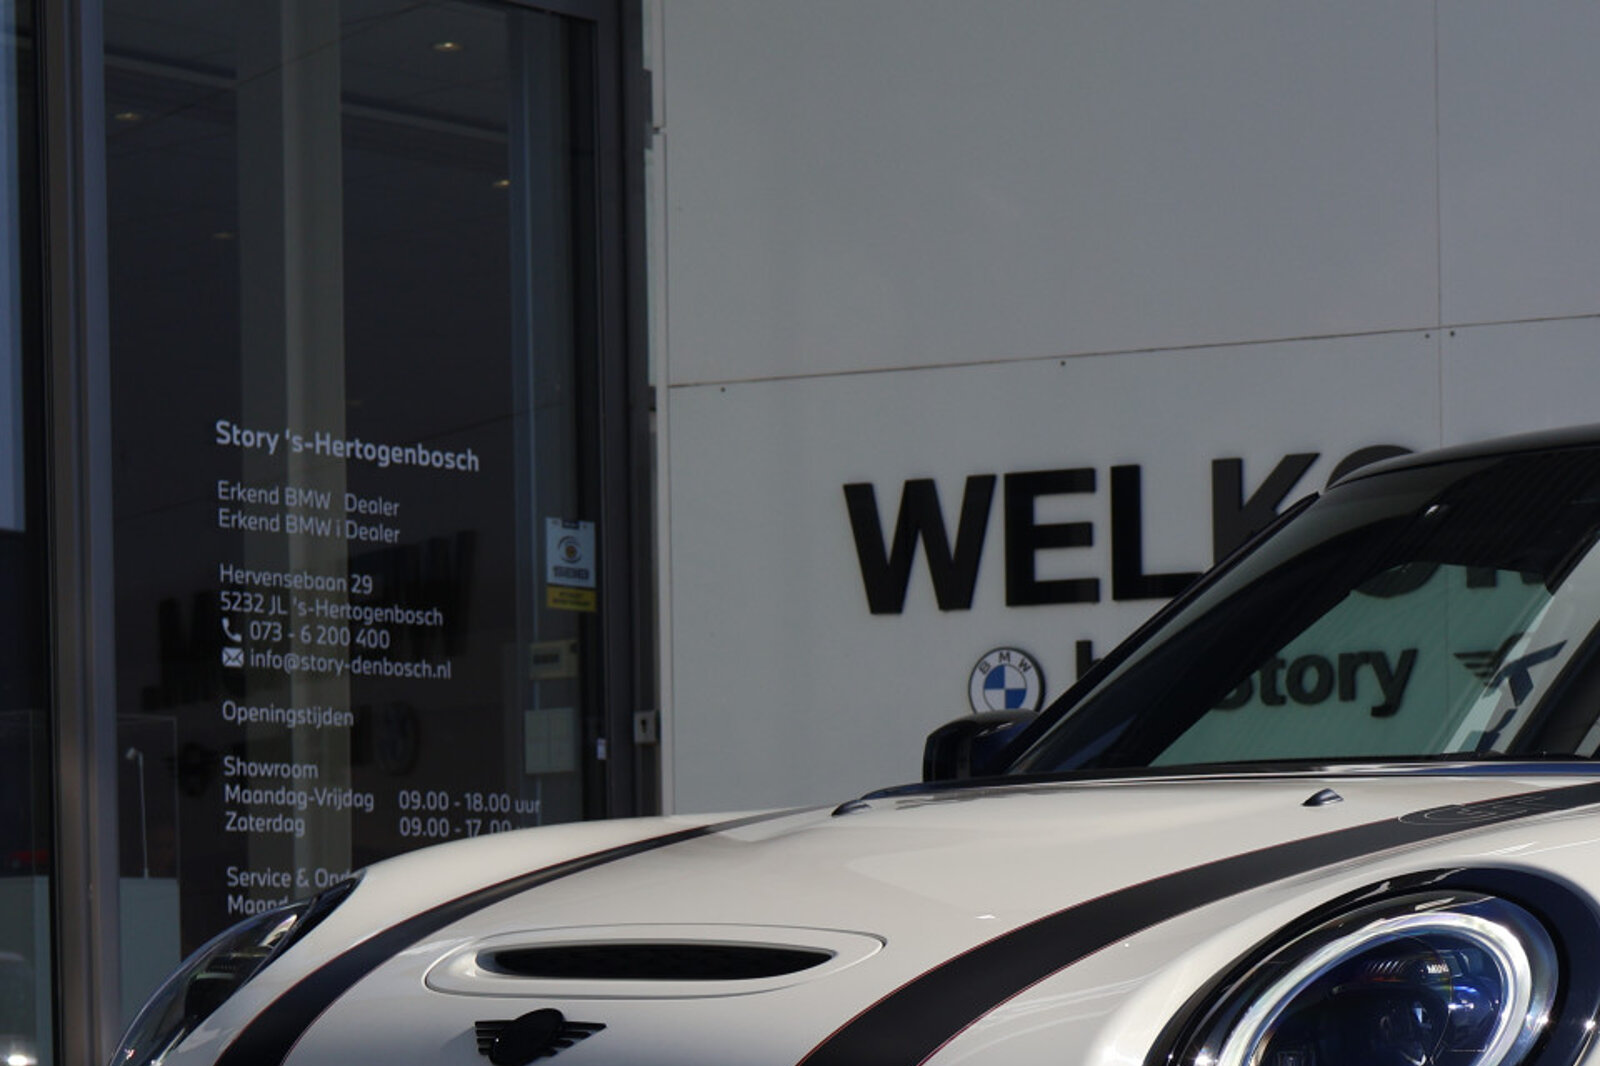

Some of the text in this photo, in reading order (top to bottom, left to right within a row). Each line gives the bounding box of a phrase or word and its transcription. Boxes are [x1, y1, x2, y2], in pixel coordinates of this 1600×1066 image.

[216, 420, 279, 455] Story
[217, 480, 400, 518] Erkend BMW Dealer
[218, 508, 280, 534] Erkend
[285, 515, 331, 538] BMW
[345, 520, 400, 545] Dealer
[843, 445, 1547, 615] WELK
[219, 563, 373, 595] Hervensebaan 29
[220, 591, 265, 614] 5232
[269, 596, 288, 617] JL
[250, 620, 282, 642] 073
[300, 625, 312, 645] 6
[316, 625, 351, 647] 200
[356, 628, 390, 650] 400
[250, 649, 452, 680] info@story-denbosch.nl
[222, 700, 354, 729] Openingstijden
[223, 756, 319, 779] Showroom
[224, 784, 375, 812] Maandag-Vrijdag
[398, 789, 449, 812] 09.00
[464, 792, 511, 814] 18.00
[225, 812, 305, 838] Zaterdag
[399, 816, 450, 838] 09.00
[226, 866, 292, 888] Service
[295, 867, 310, 888] &
